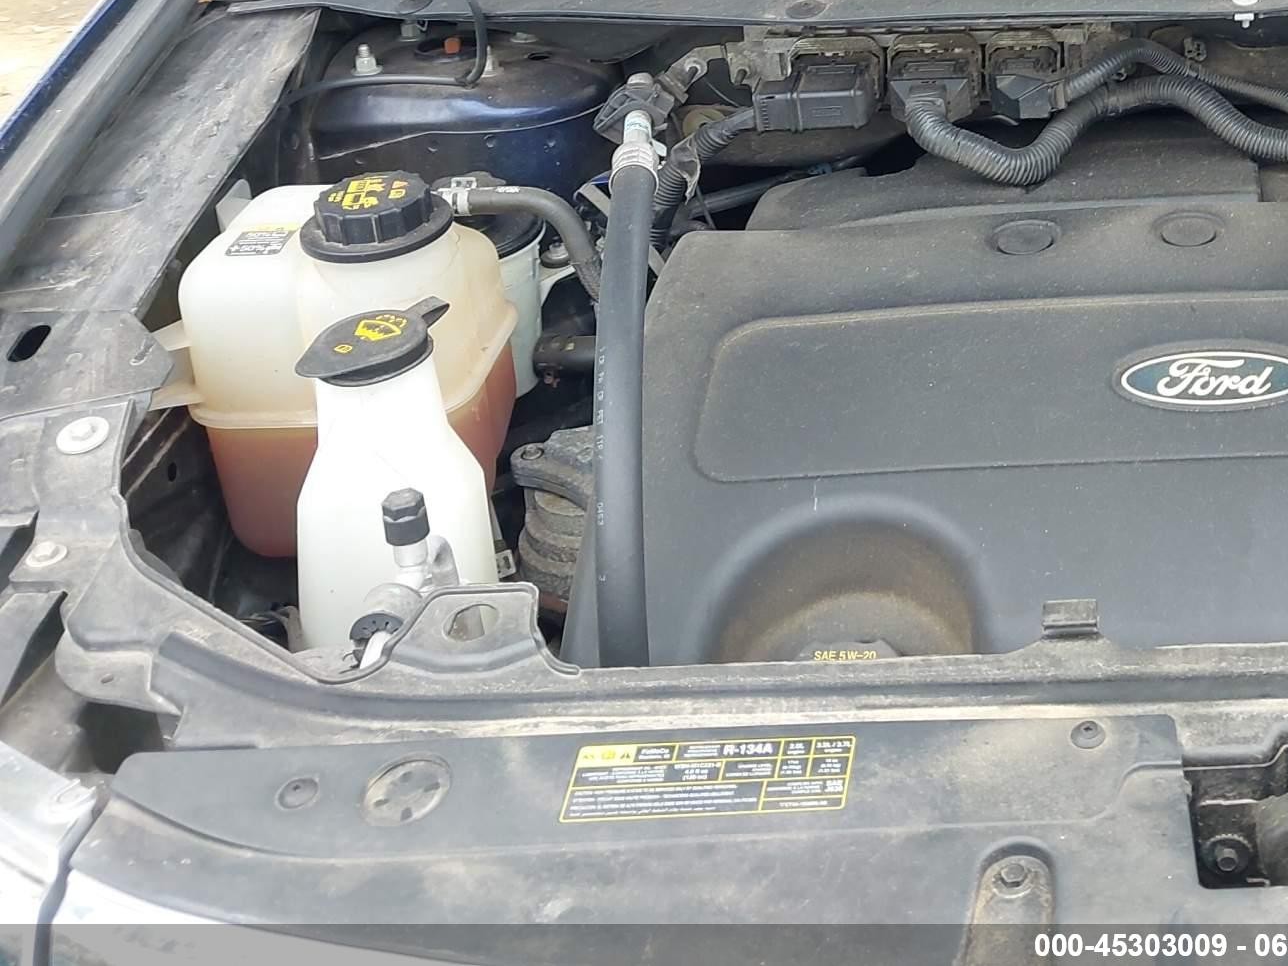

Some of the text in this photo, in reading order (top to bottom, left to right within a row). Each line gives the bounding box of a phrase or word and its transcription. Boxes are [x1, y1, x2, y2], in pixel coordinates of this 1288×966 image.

[1156, 357, 1273, 396] Ford
[814, 650, 877, 661] SAE 5W-20
[723, 743, 773, 755] R-134A
